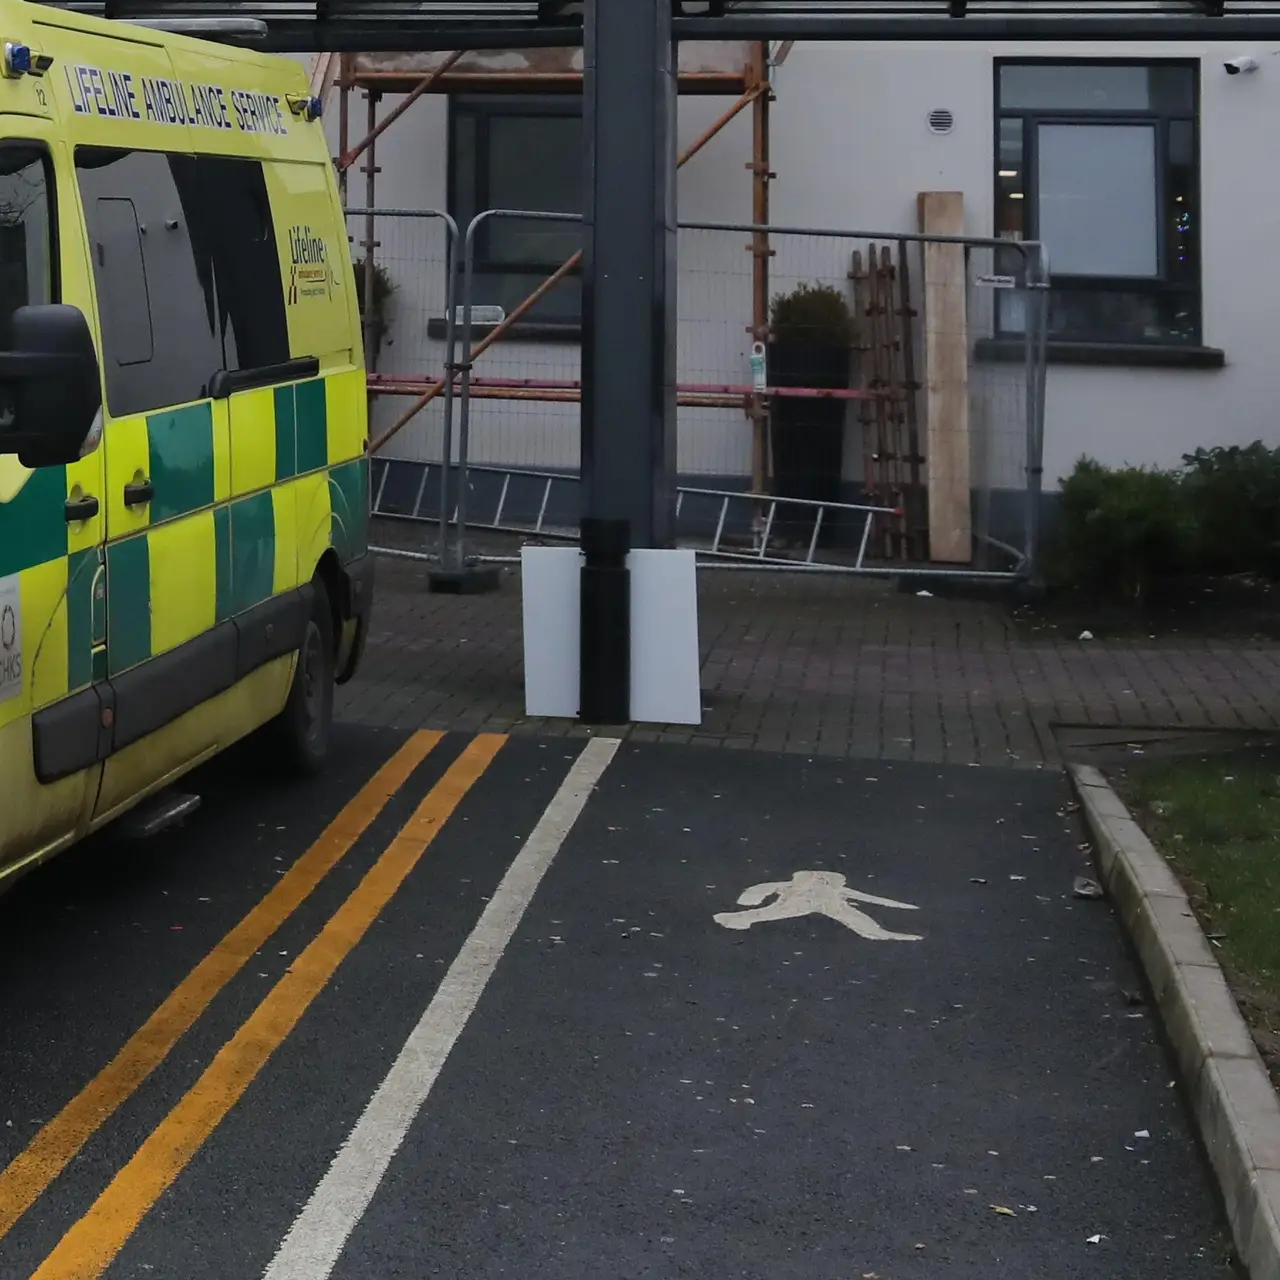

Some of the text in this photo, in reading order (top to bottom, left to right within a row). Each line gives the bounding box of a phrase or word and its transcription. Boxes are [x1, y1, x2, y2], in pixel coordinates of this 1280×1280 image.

[64, 65, 288, 134] LIFELINE AMBULANCE SERVICE
[288, 225, 326, 265] Lifeline
